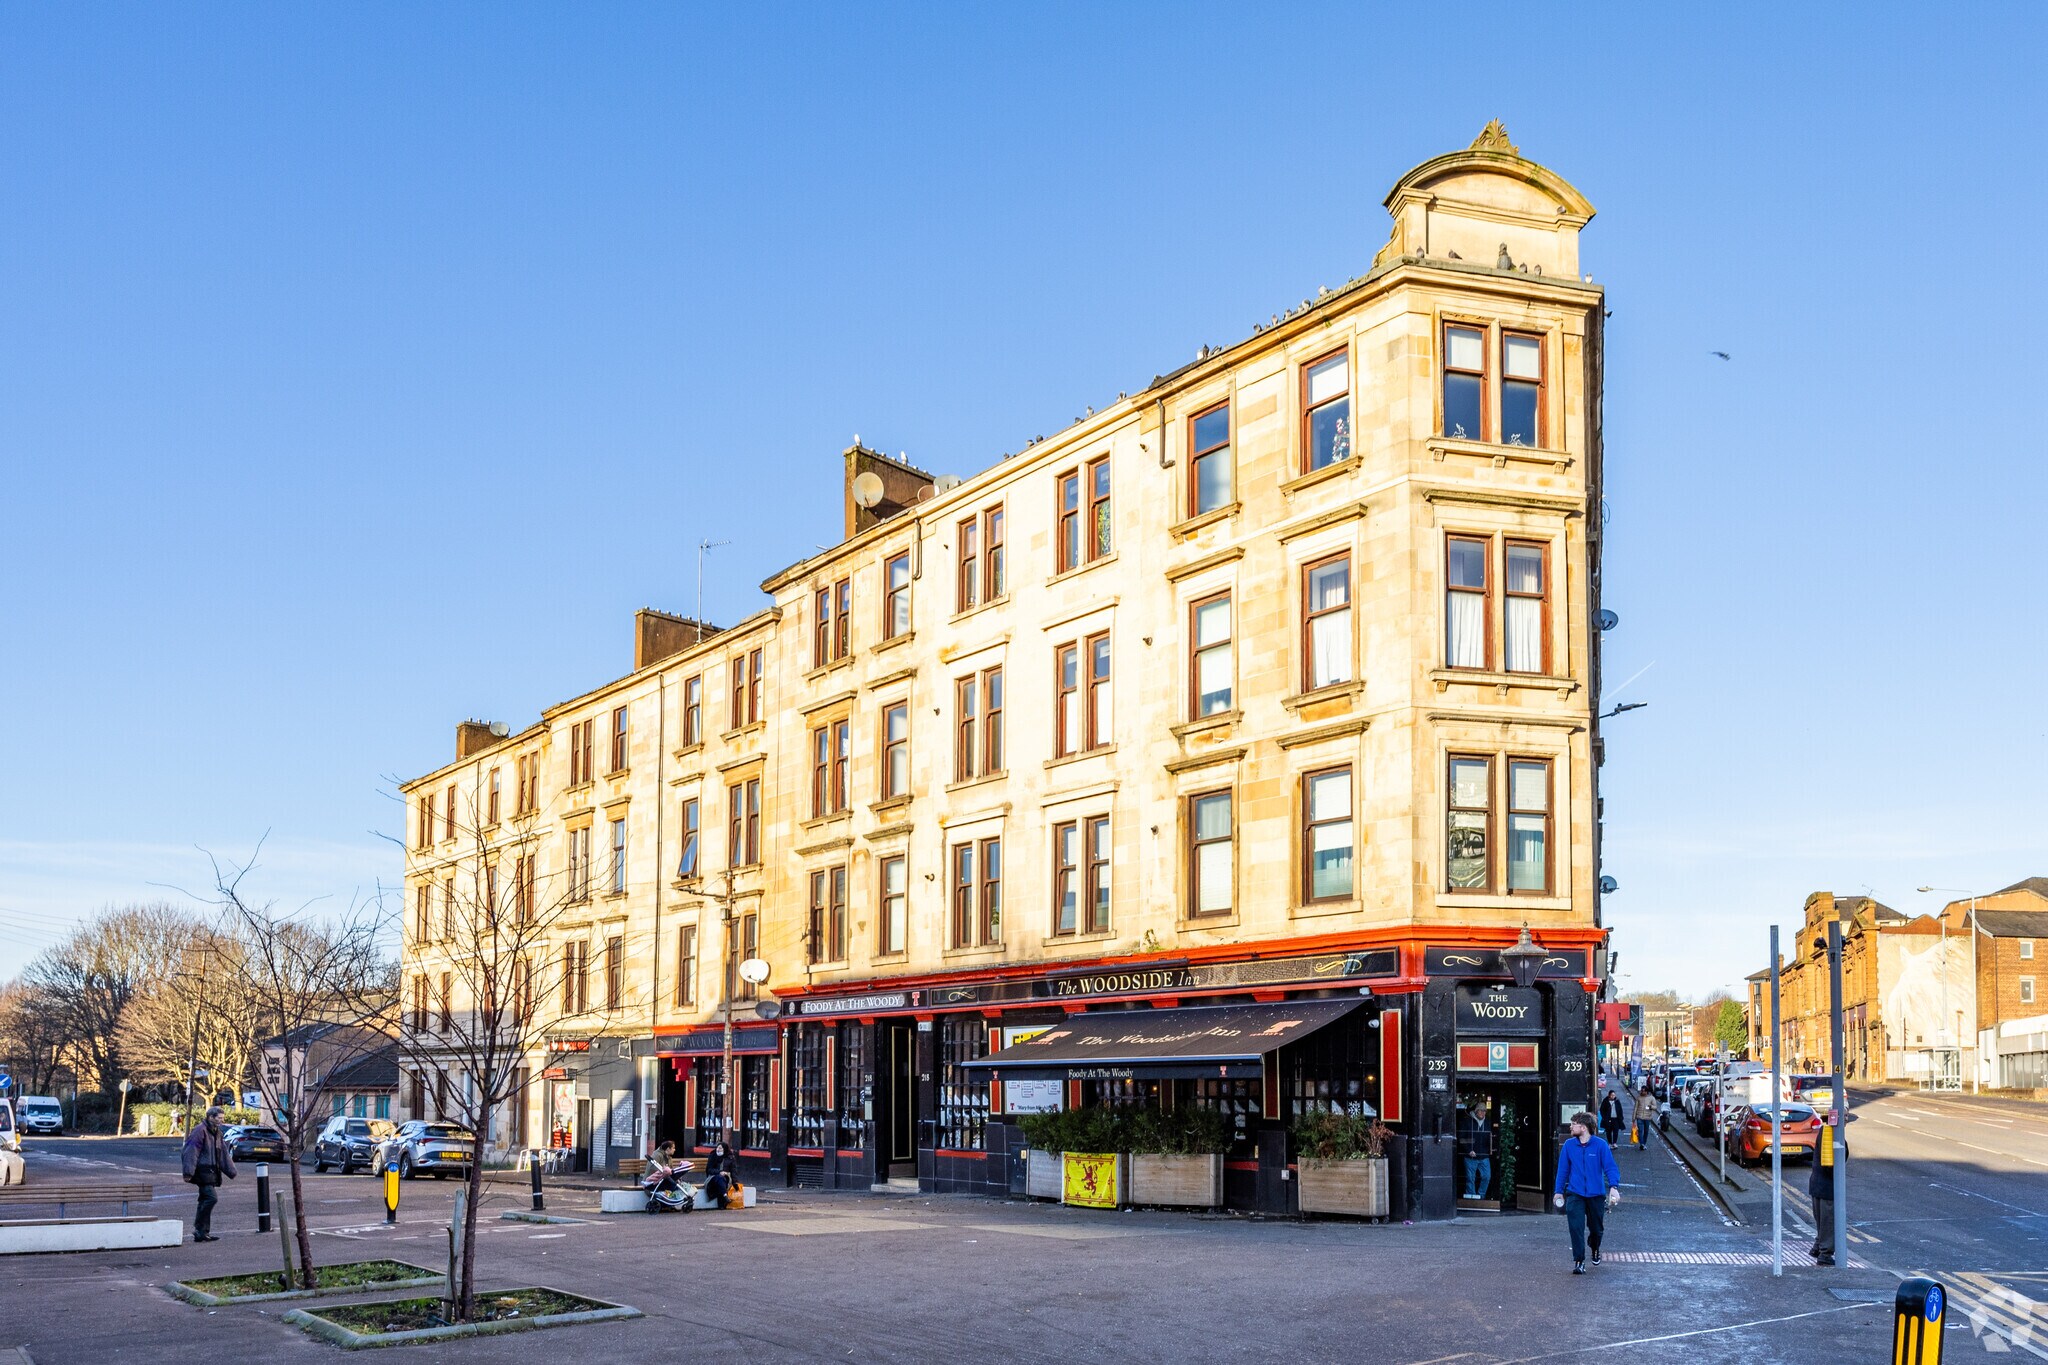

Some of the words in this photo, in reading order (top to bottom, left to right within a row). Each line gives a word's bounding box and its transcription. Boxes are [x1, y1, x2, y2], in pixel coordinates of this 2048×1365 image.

[1058, 980, 1077, 995] The
[1080, 971, 1173, 994] WOODSIDE
[1178, 971, 1200, 986] Inn
[1489, 994, 1508, 1002] THE
[805, 1001, 833, 1012] FOODY
[835, 1000, 847, 1010] AT
[848, 998, 866, 1009] THE
[867, 996, 900, 1007] WOODY
[1471, 1002, 1528, 1019] WOODY
[1076, 1036, 1111, 1045] The
[1116, 1030, 1201, 1044] Woodside
[1202, 1026, 1242, 1037] Inn
[1428, 1060, 1447, 1071] 239
[1564, 1061, 1582, 1072] 239
[1835, 1065, 1840, 1073] 4
[1068, 1069, 1087, 1079] Foody
[1088, 1069, 1096, 1077] At
[1097, 1069, 1110, 1077] The
[1111, 1068, 1133, 1079] Woody
